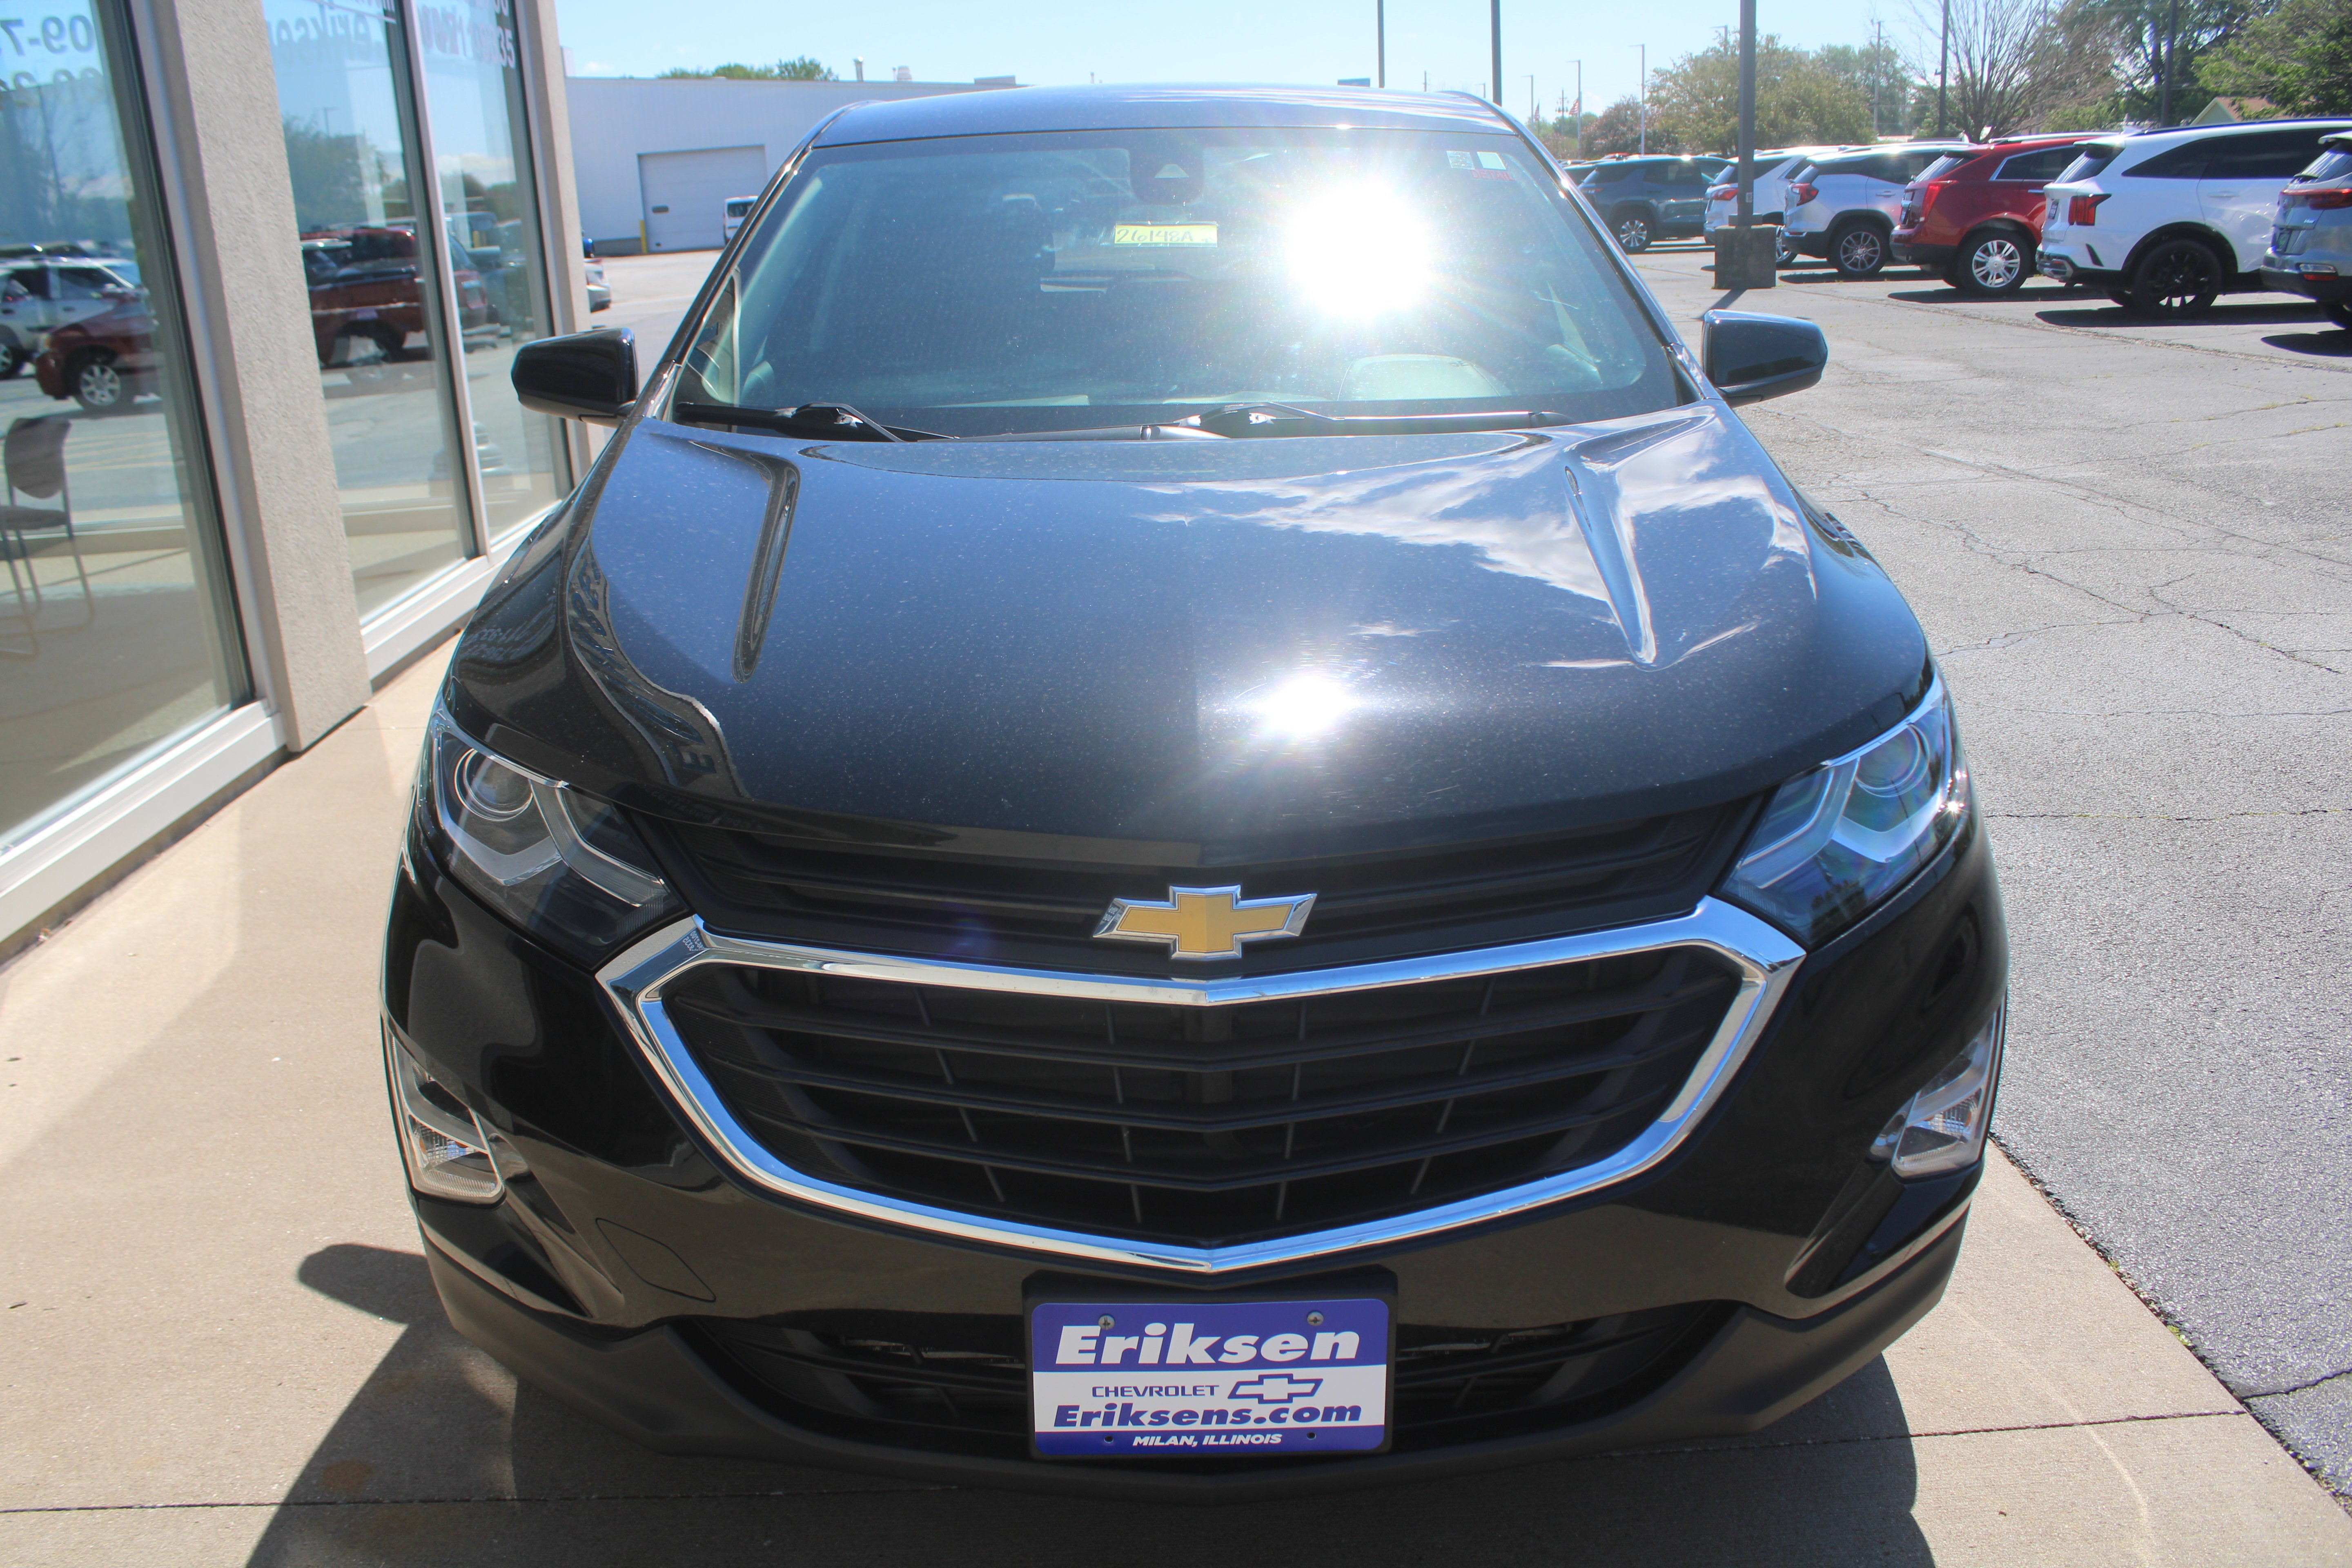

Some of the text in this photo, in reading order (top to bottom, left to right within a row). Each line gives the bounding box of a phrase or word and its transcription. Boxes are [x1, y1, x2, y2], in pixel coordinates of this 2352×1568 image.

[1471, 169, 1516, 181] DETAIL
[1116, 229, 1194, 243] 26148A
[1055, 1323, 1360, 1364] Eriksen
[1091, 1385, 1220, 1398] CHEVROLET
[1054, 1403, 1362, 1428] Eriksens.com
[1132, 1433, 1283, 1448] MILAN, ILLINOIS
